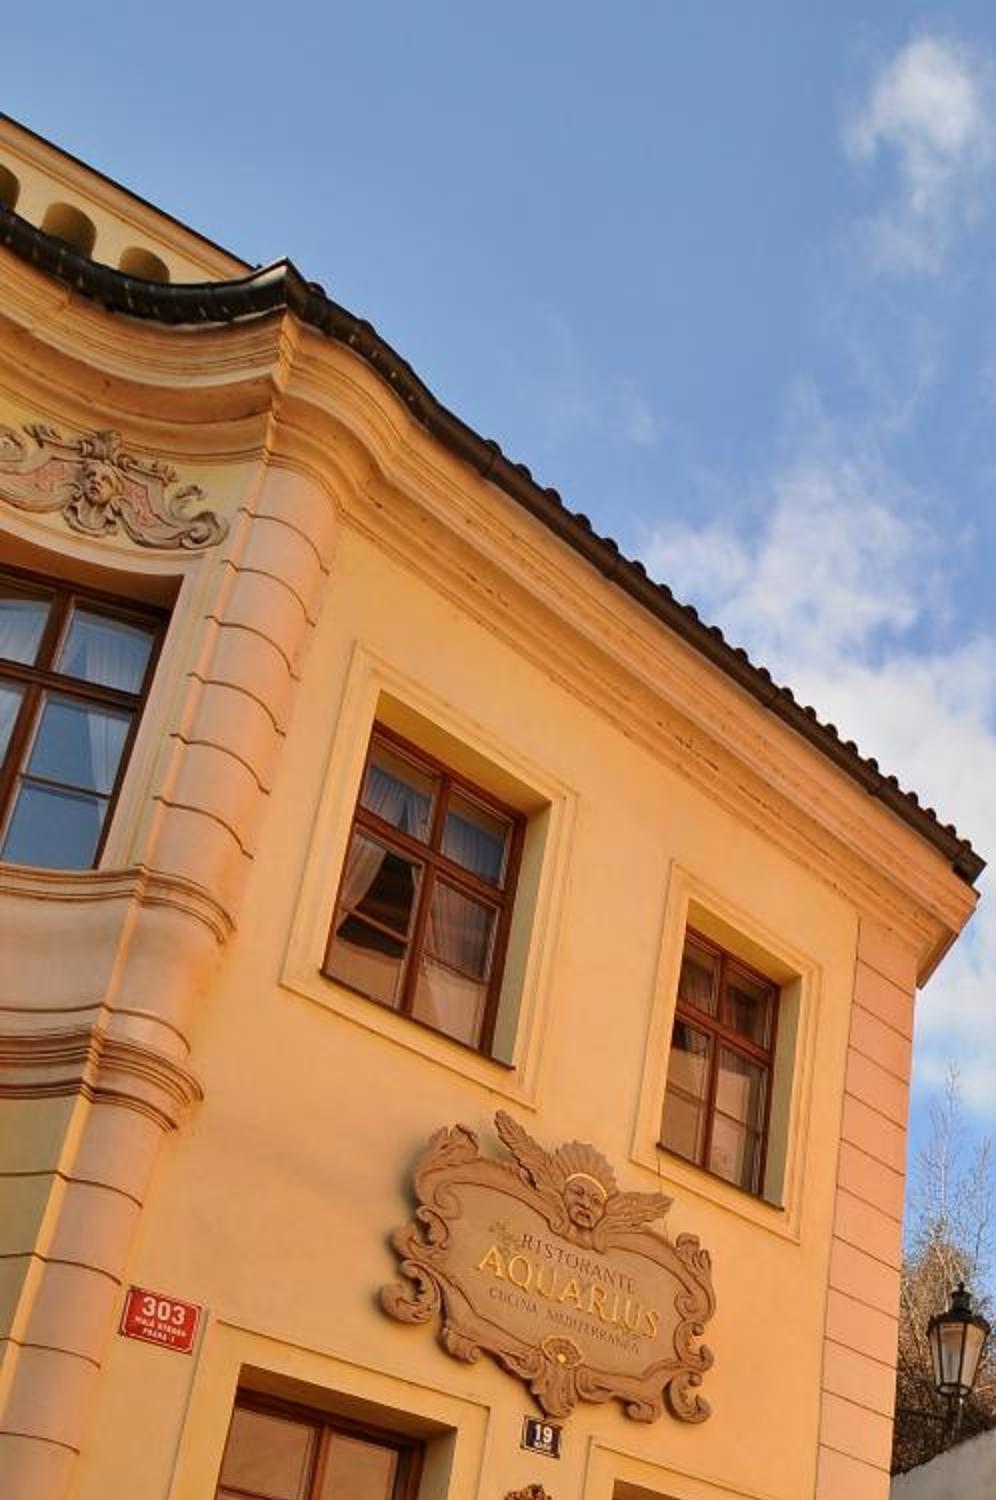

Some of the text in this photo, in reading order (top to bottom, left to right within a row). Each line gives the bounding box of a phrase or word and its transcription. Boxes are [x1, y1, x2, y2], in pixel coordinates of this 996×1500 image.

[521, 1234, 636, 1294] RISTORANTE
[479, 1247, 660, 1339] AQUARIUS
[489, 1287, 537, 1313] CUCINA
[142, 1296, 186, 1325] 303
[535, 1423, 553, 1443] 19
